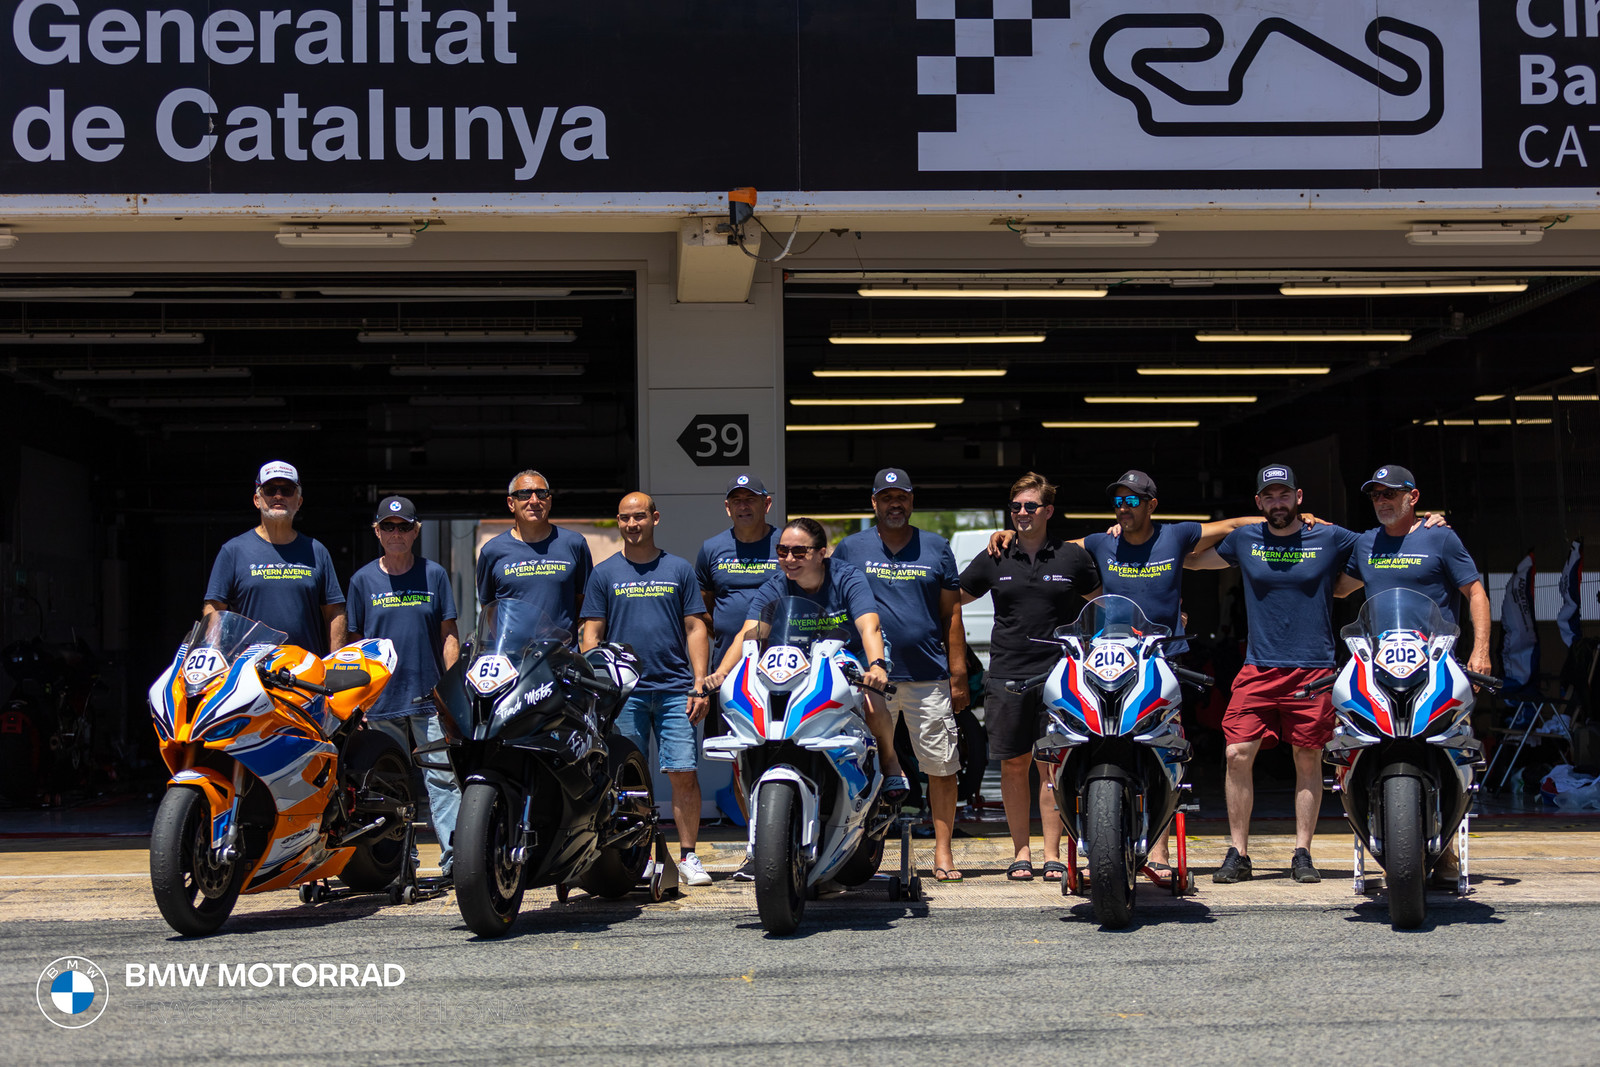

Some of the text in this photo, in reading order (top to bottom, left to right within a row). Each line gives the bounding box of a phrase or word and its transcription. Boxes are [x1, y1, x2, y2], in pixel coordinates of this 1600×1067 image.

[12, 0, 518, 65] Generalitat
[1519, 54, 1598, 106] Ba
[12, 88, 609, 181] de Catalunya
[696, 423, 744, 457] 39
[1251, 549, 1316, 559] BAYERN AVENUE
[251, 569, 312, 577] BAYERN AVENUE
[504, 565, 535, 576] BAYERN
[897, 569, 927, 577] AVENUE
[1108, 563, 1172, 574] BAYERN AVENUE
[615, 586, 674, 596] BAYERN AVENUE
[372, 594, 431, 606] BAYERN AVENUE
[817, 614, 849, 626] AVENUE
[1094, 651, 1126, 668] 204
[1385, 647, 1417, 665] 202
[186, 654, 217, 672] 201
